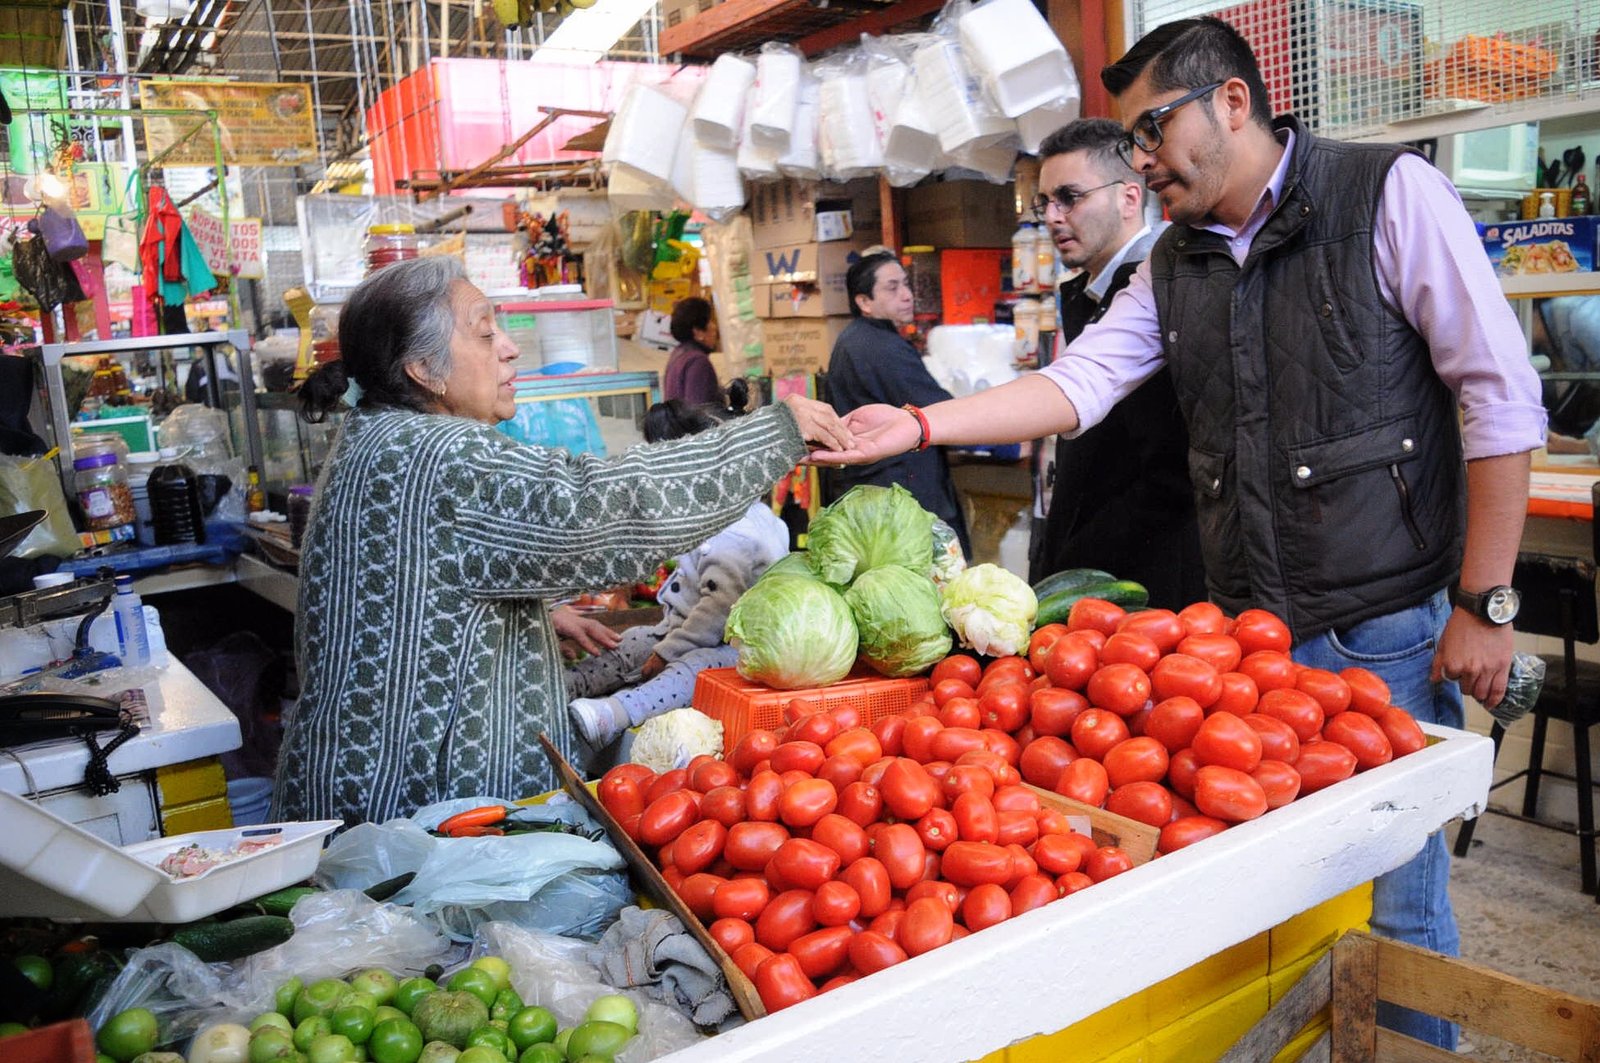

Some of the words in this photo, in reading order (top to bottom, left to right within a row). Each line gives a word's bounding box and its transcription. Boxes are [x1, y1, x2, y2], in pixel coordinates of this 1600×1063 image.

[192, 210, 258, 236] NOPALTOS
[1502, 222, 1574, 248] SALADITAS
[766, 248, 800, 276] W
